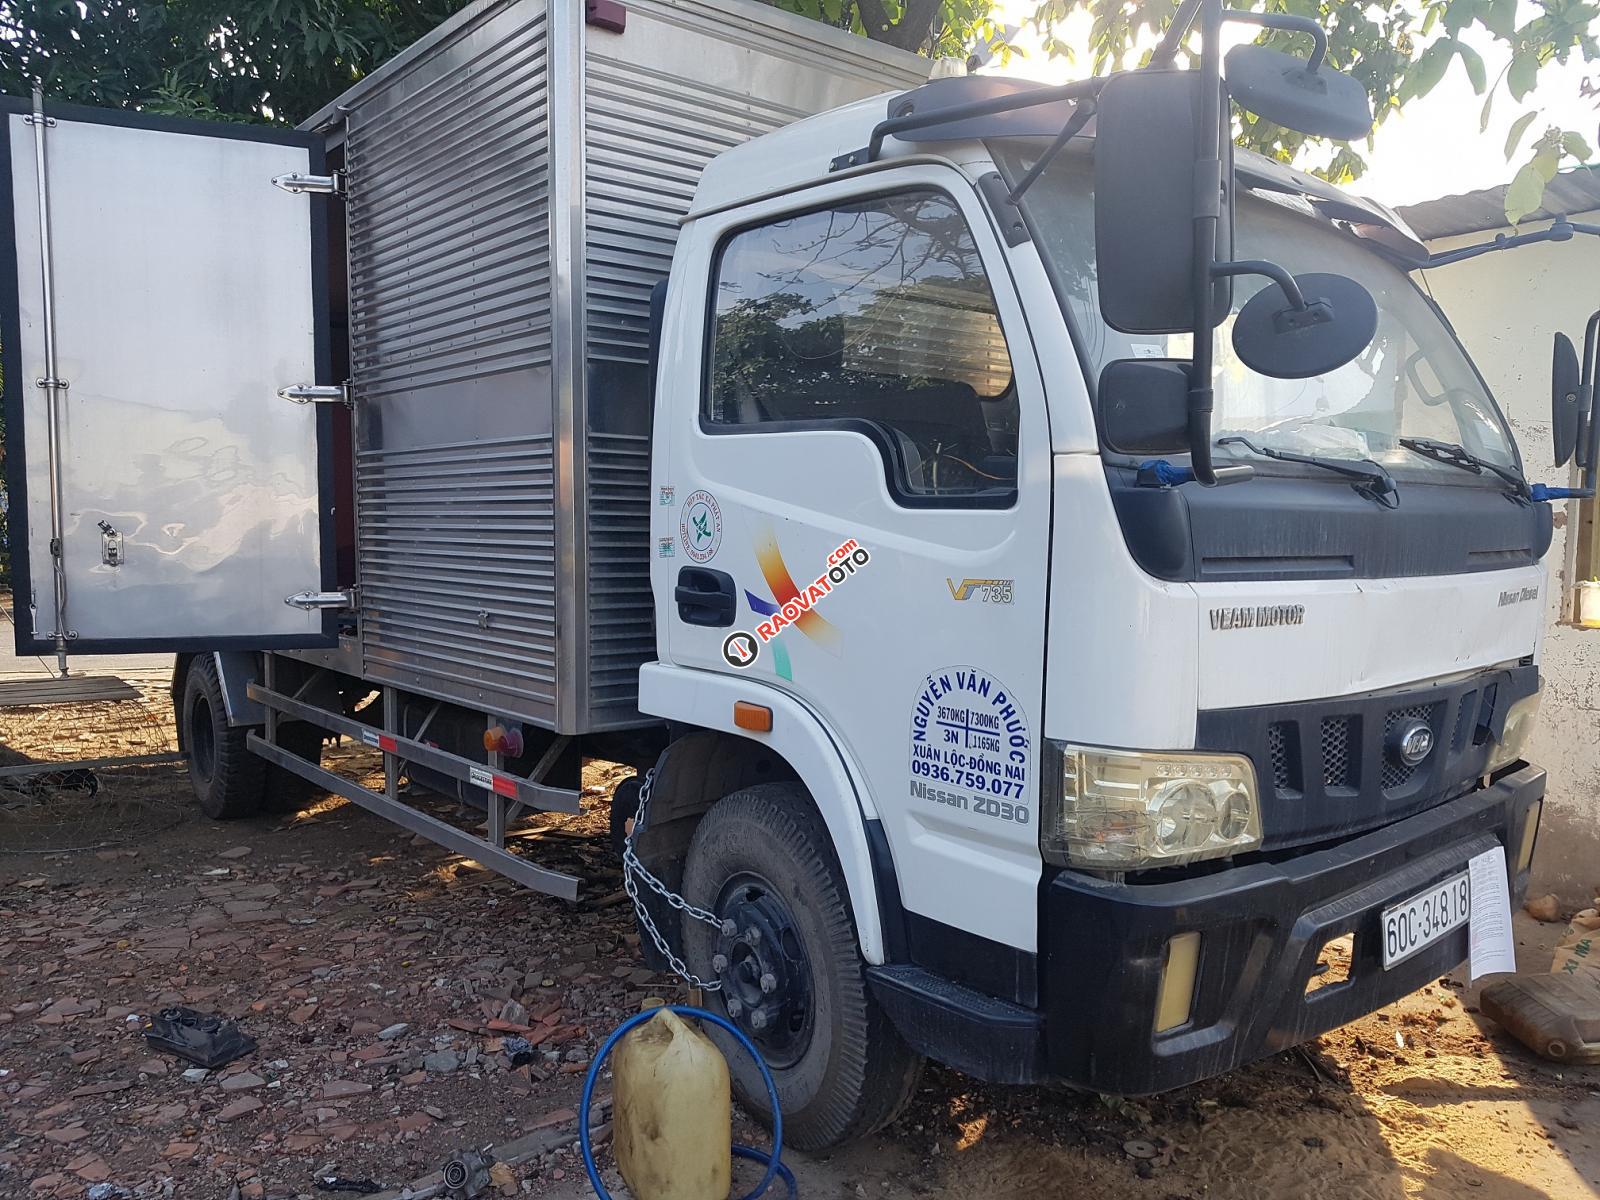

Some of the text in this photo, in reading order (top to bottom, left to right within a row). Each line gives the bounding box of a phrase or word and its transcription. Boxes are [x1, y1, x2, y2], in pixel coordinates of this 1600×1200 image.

[982, 585, 1013, 603] 735
[1209, 604, 1305, 630] VEAM MOTOR
[913, 669, 1030, 764] NGUYỄN VĂN PHƯỚC
[937, 705, 965, 724] 3670KG
[970, 711, 1000, 730] 7300KG
[943, 729, 959, 745] 3N
[913, 743, 1025, 782] XUÂN LỘC-ĐỒNG NAI
[911, 759, 1025, 800] 0936.759.077
[910, 780, 1030, 825] Nissan ZD30
